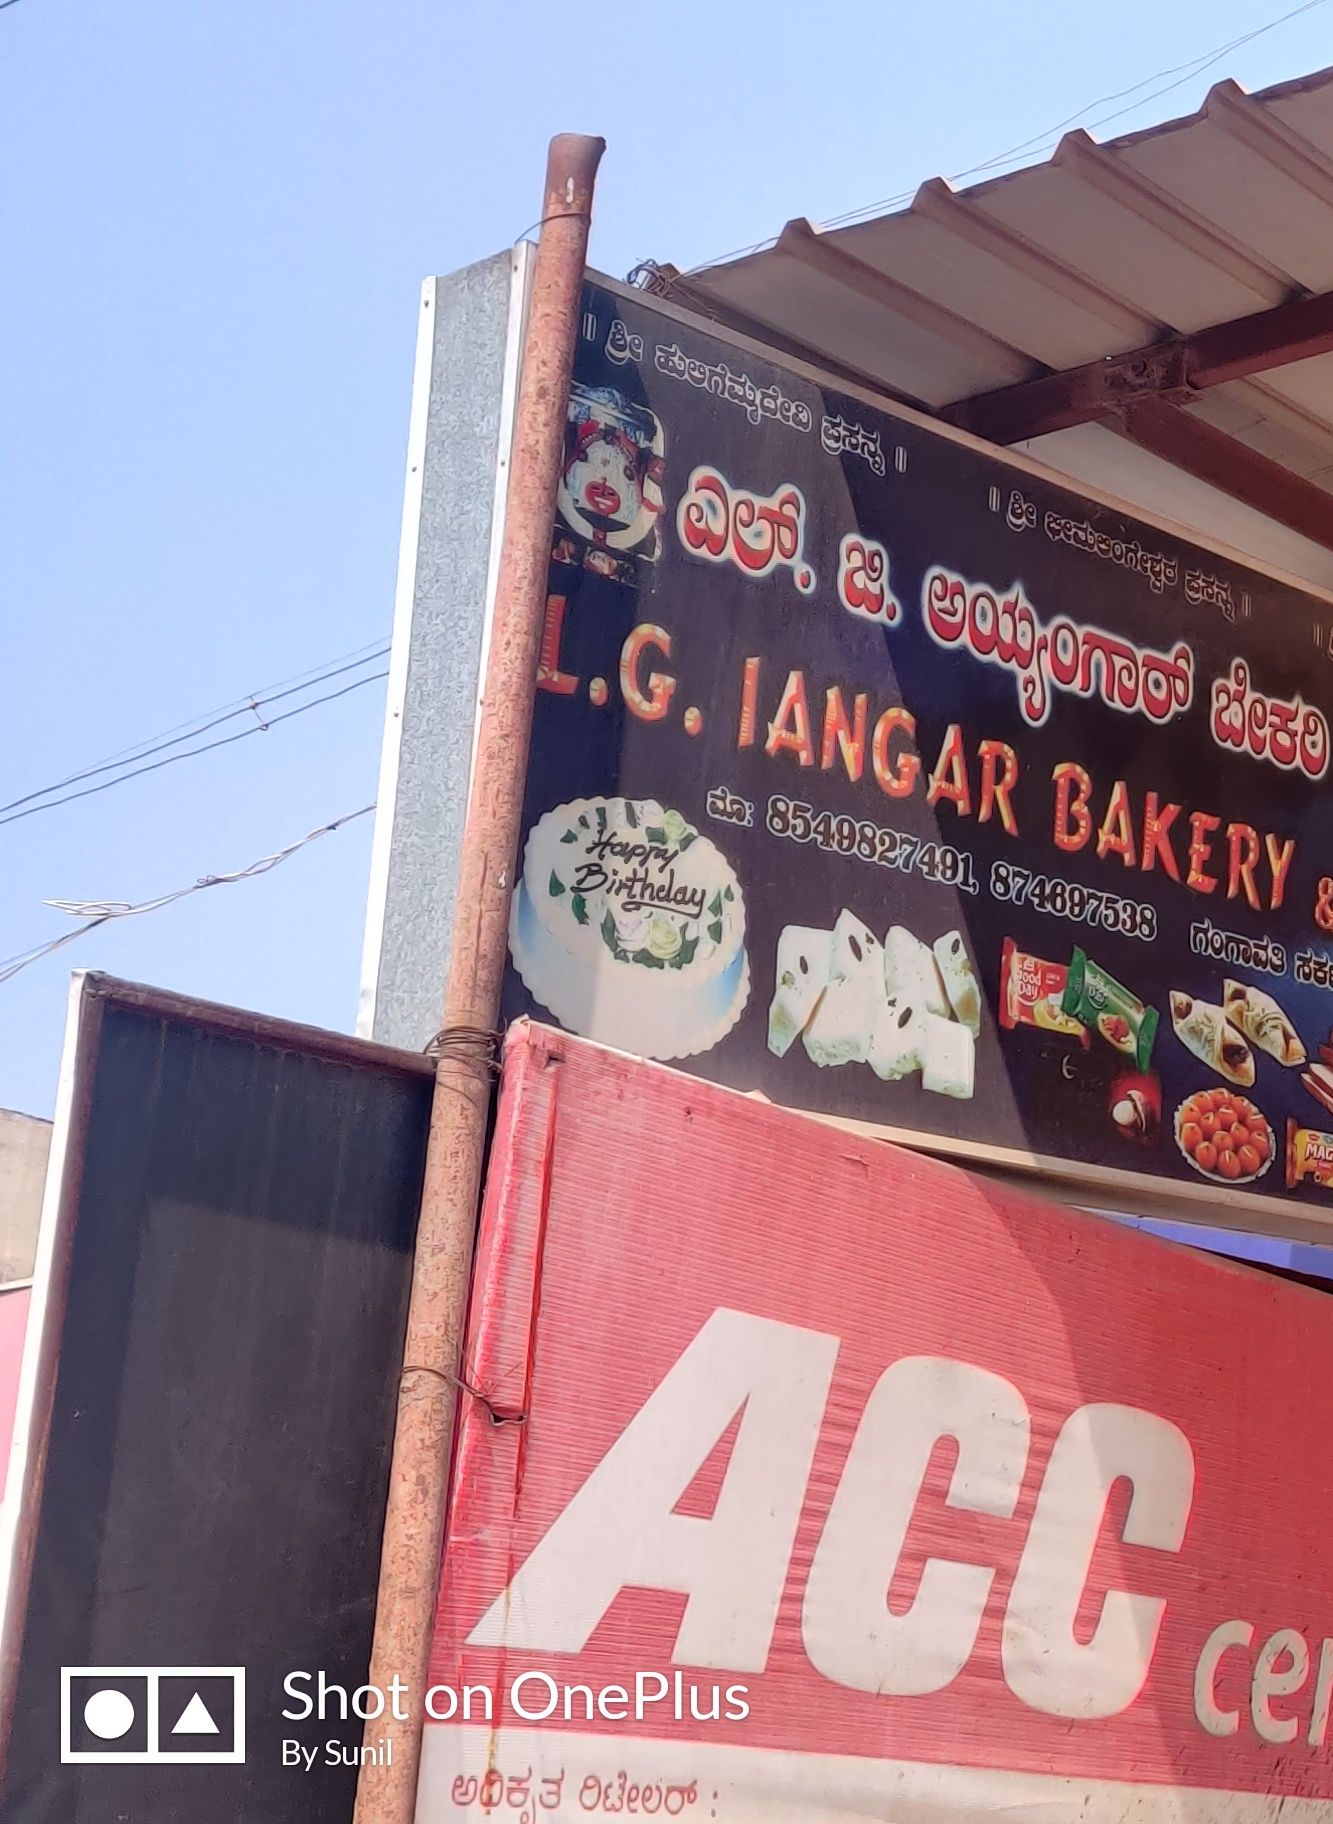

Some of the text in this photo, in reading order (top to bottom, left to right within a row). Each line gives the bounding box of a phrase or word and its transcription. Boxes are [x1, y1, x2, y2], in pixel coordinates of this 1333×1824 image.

[605, 319, 643, 365] ಶ್ರೀ
[820, 414, 886, 477] ಪ್ರಸನ್ನ
[1006, 490, 1037, 532] ಶ್ರೀ
[842, 538, 900, 624] ಜಿ.
[926, 569, 1193, 724] ಅಯ್ಯಂಗಾರ್
[1211, 658, 1330, 779] ಬೇಕರಿ
[737, 656, 1020, 838] IANGAR
[1052, 762, 1297, 911] BAKERY
[585, 828, 679, 873] Happy
[570, 863, 706, 919] Birthday
[1190, 918, 1287, 976] ಗಂಗಾವತಿ
[464, 1306, 1197, 1720] ACC
[579, 1769, 698, 1816] ರಿಟೇಲರ್
